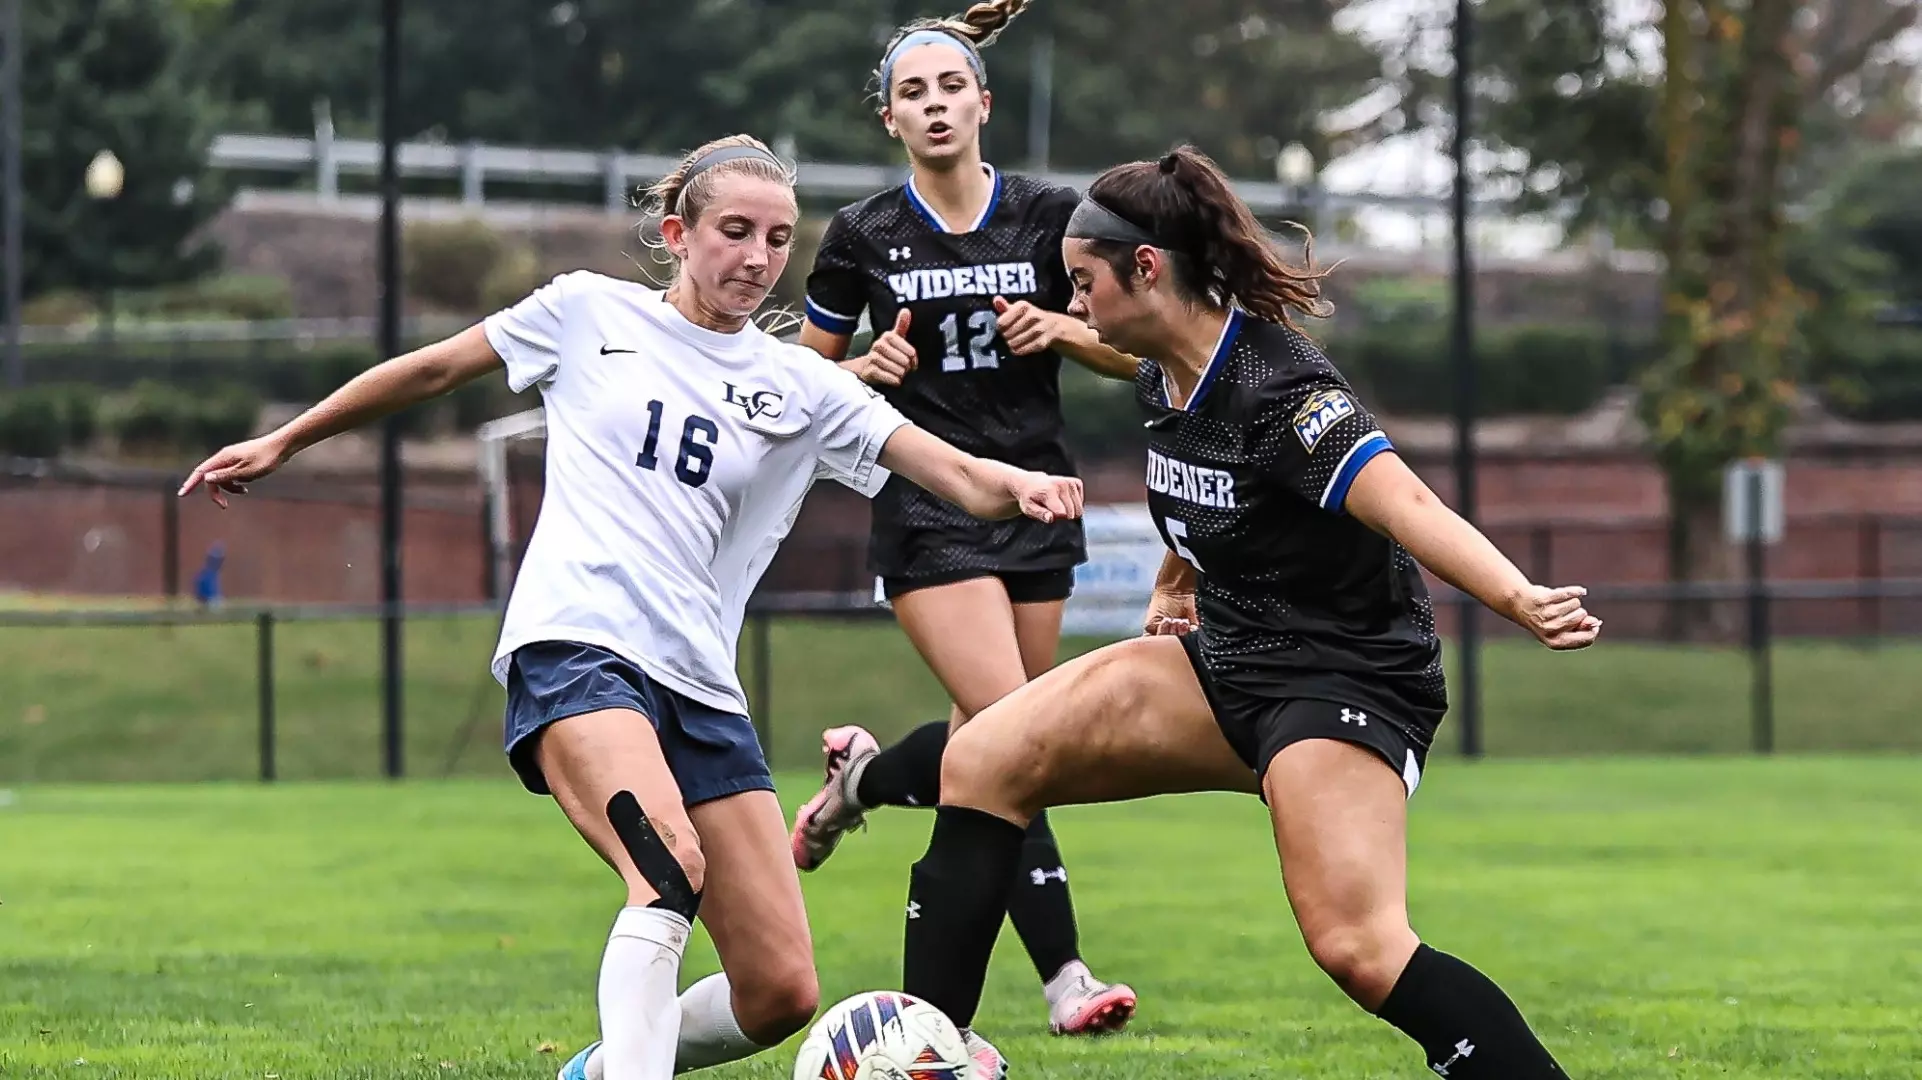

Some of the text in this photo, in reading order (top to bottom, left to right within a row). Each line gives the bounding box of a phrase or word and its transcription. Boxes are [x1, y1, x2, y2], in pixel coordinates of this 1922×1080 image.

[887, 261, 1038, 304] WIDENER
[938, 309, 1000, 373] 12
[721, 380, 784, 421] LVC
[1302, 398, 1351, 447] MAC
[635, 398, 719, 489] 16
[1145, 448, 1236, 509] IDENER
